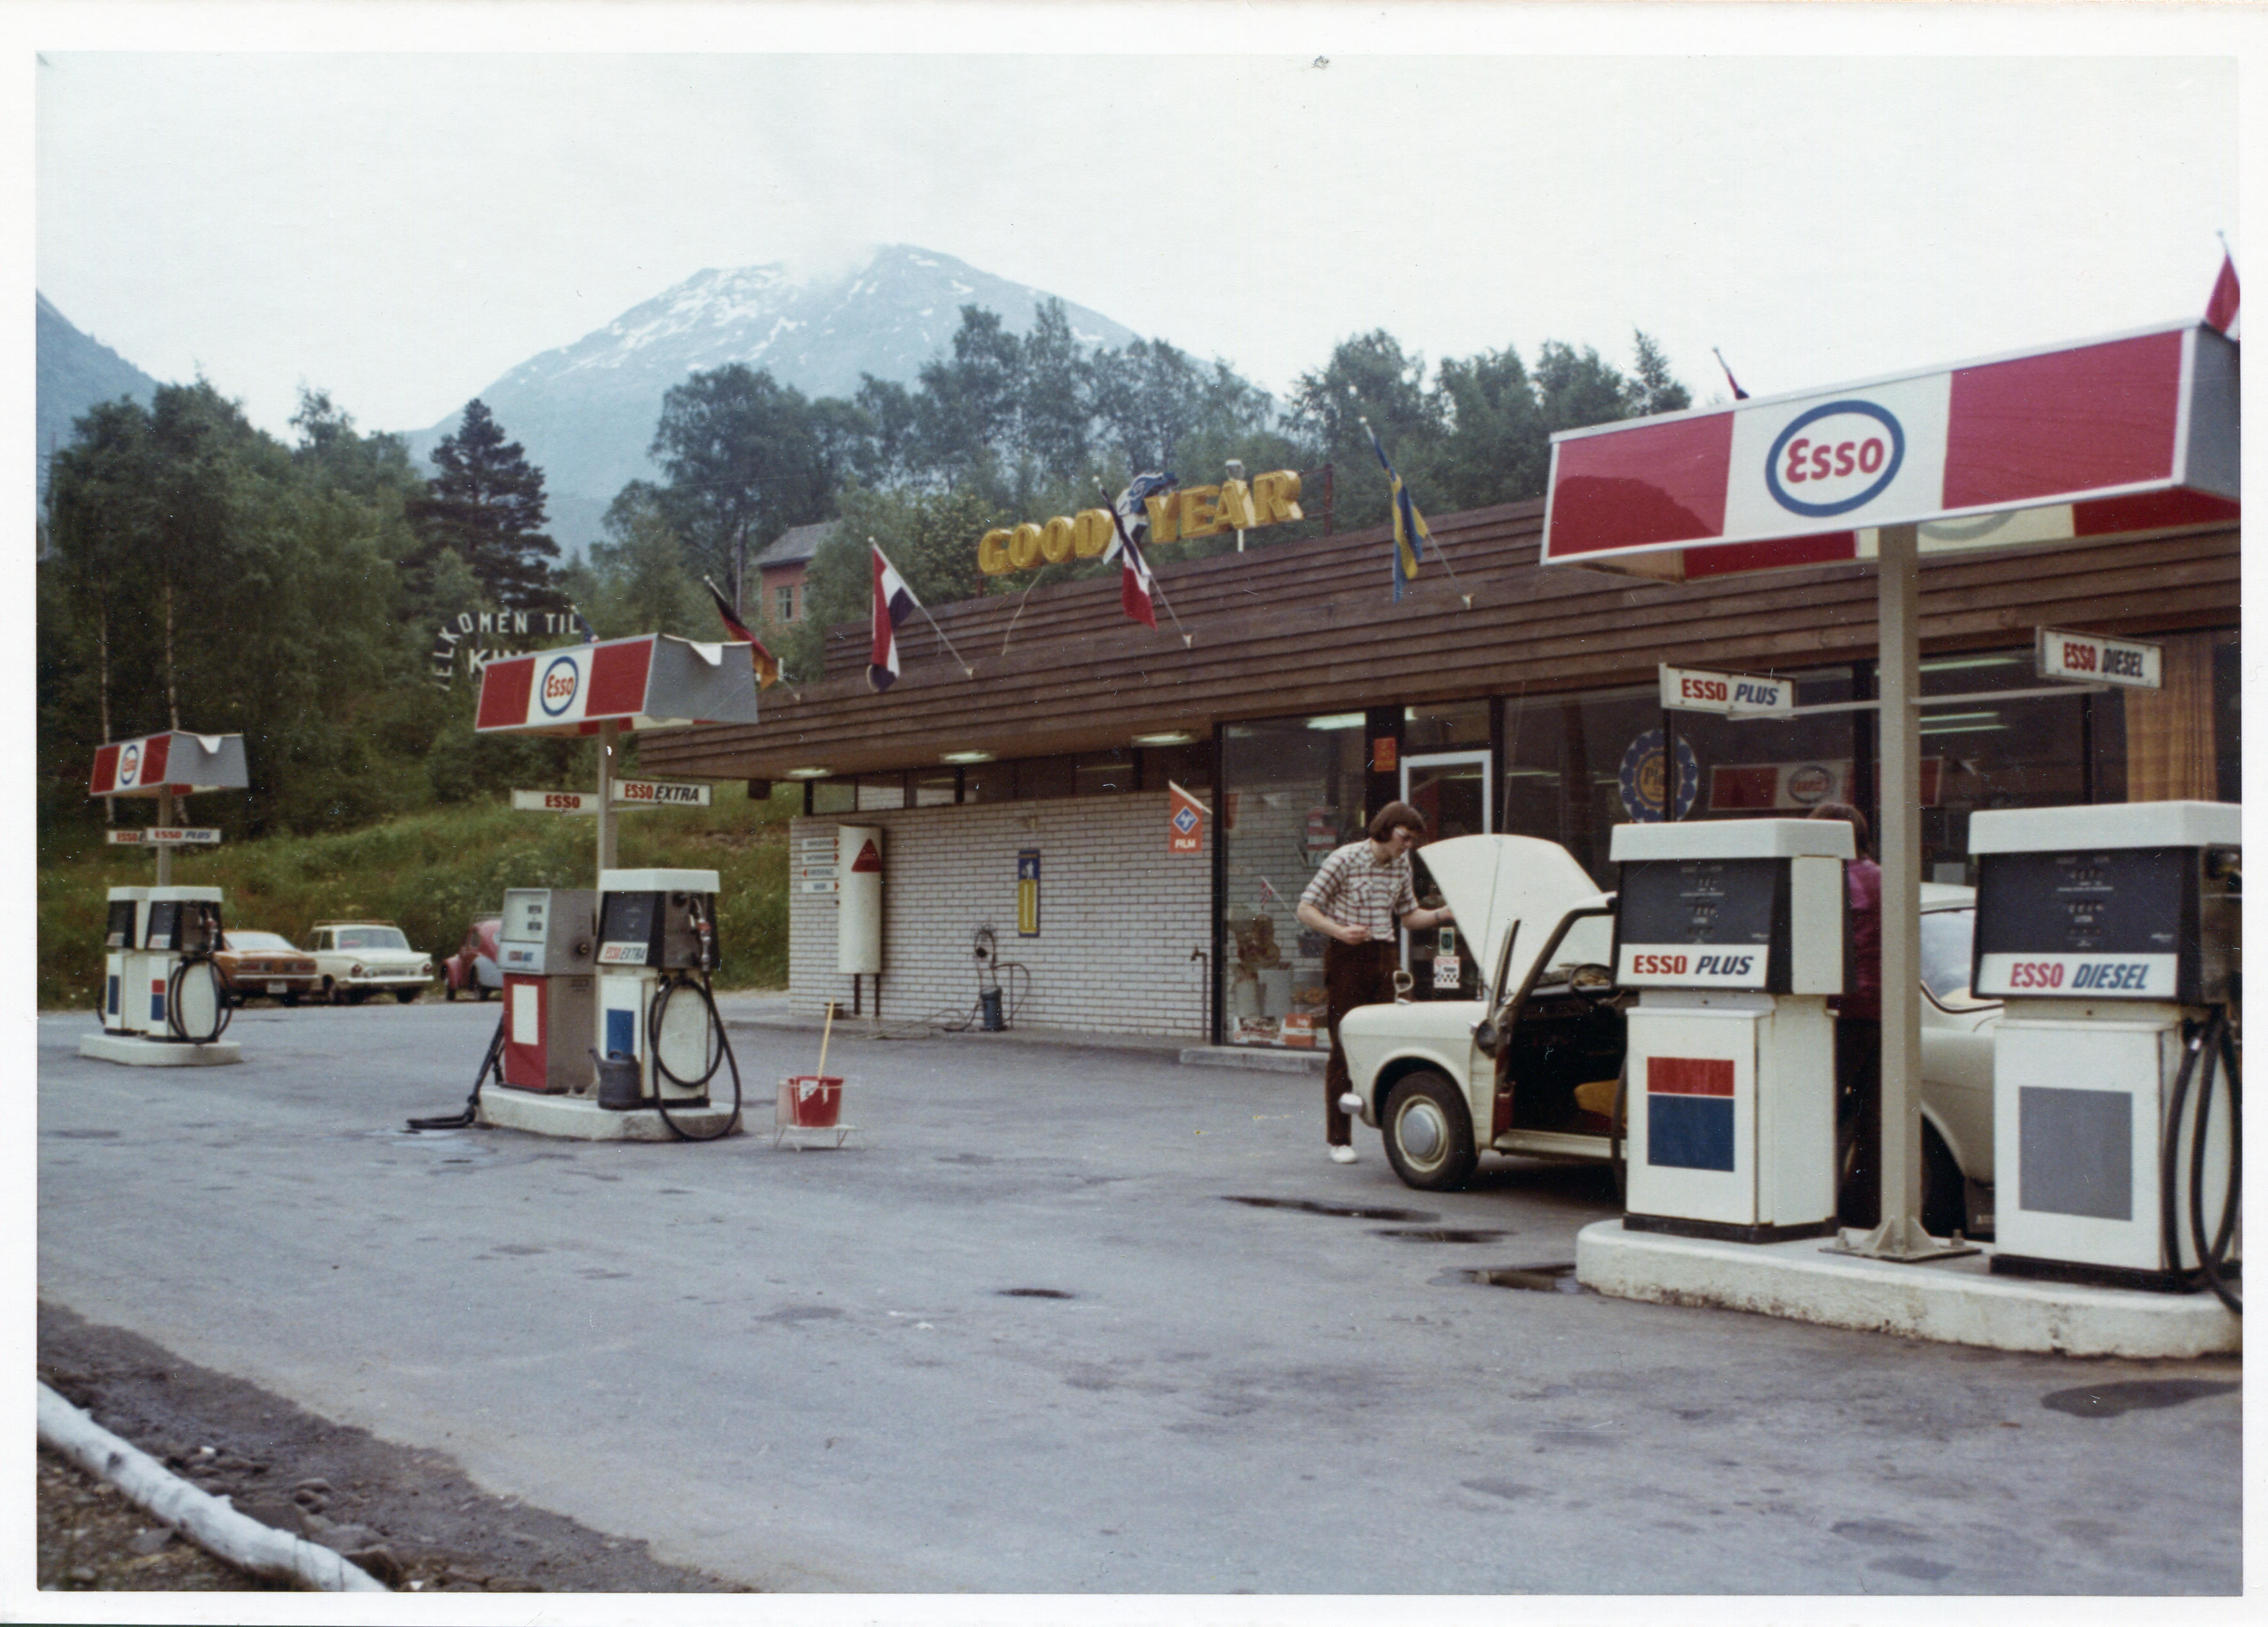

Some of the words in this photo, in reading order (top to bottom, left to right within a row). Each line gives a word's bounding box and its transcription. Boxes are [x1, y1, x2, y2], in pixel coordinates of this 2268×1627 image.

[1786, 437, 1884, 484] Esso
[977, 508, 1116, 576] GOOD
[1143, 470, 1304, 544] YEAR
[545, 612, 581, 635] TIL
[2064, 641, 2097, 673] ESSO
[2101, 648, 2144, 678] DIESEL
[546, 674, 575, 699] Esso
[1681, 678, 1728, 702] ESSO
[1734, 683, 1779, 706] PLUS
[544, 794, 581, 809] ESSO
[624, 783, 653, 799] ESSO
[654, 785, 699, 802] EXTRA
[1175, 838, 1196, 849] FILM
[1633, 954, 1688, 975] ESSO
[1695, 955, 1755, 976] PLUS
[2009, 962, 2064, 988] ESSO
[2071, 963, 2150, 990] DIESEL
